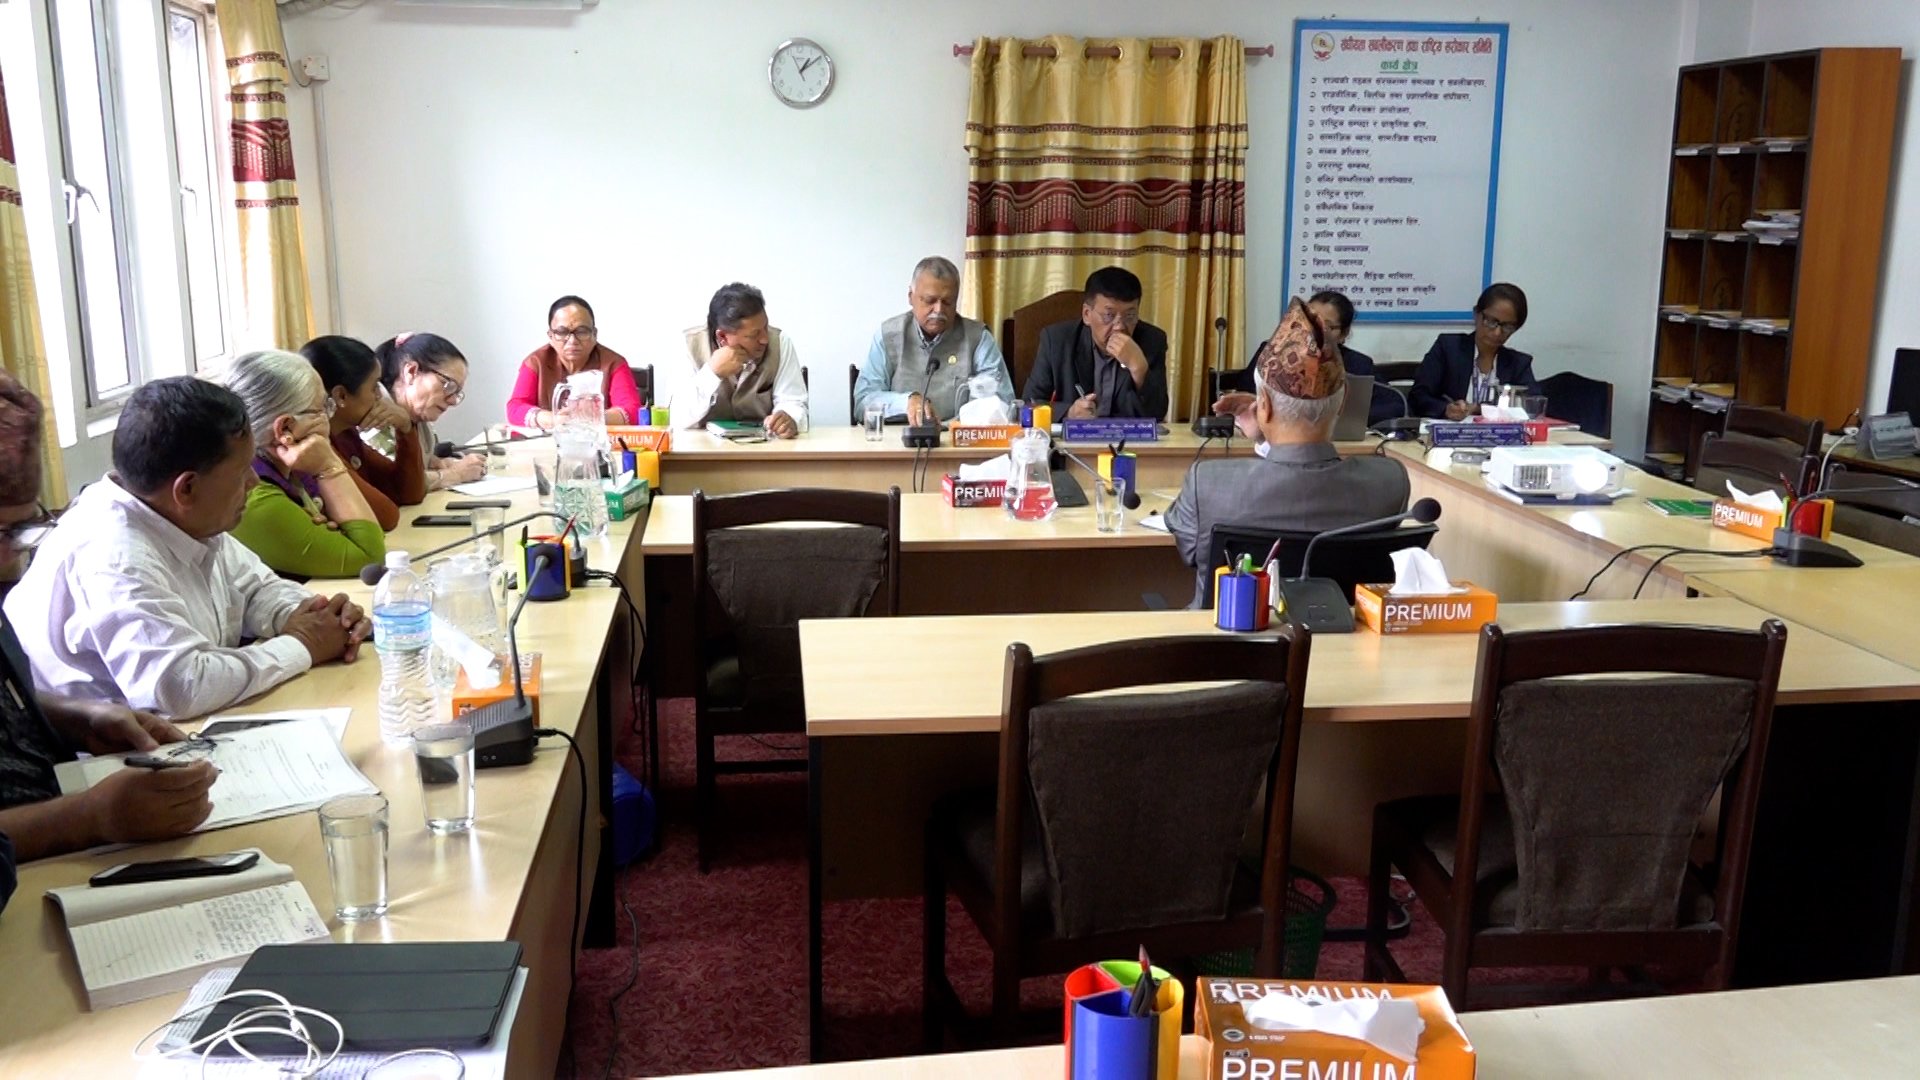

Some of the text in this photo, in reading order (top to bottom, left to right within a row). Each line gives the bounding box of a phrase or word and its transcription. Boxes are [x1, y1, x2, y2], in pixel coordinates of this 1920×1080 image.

[608, 434, 653, 445] REMIUM
[954, 429, 1007, 440] PREMIUM
[954, 487, 1006, 499] PREMI
[1714, 503, 1764, 528] PREMIUM
[1384, 603, 1472, 622] PREMIUM
